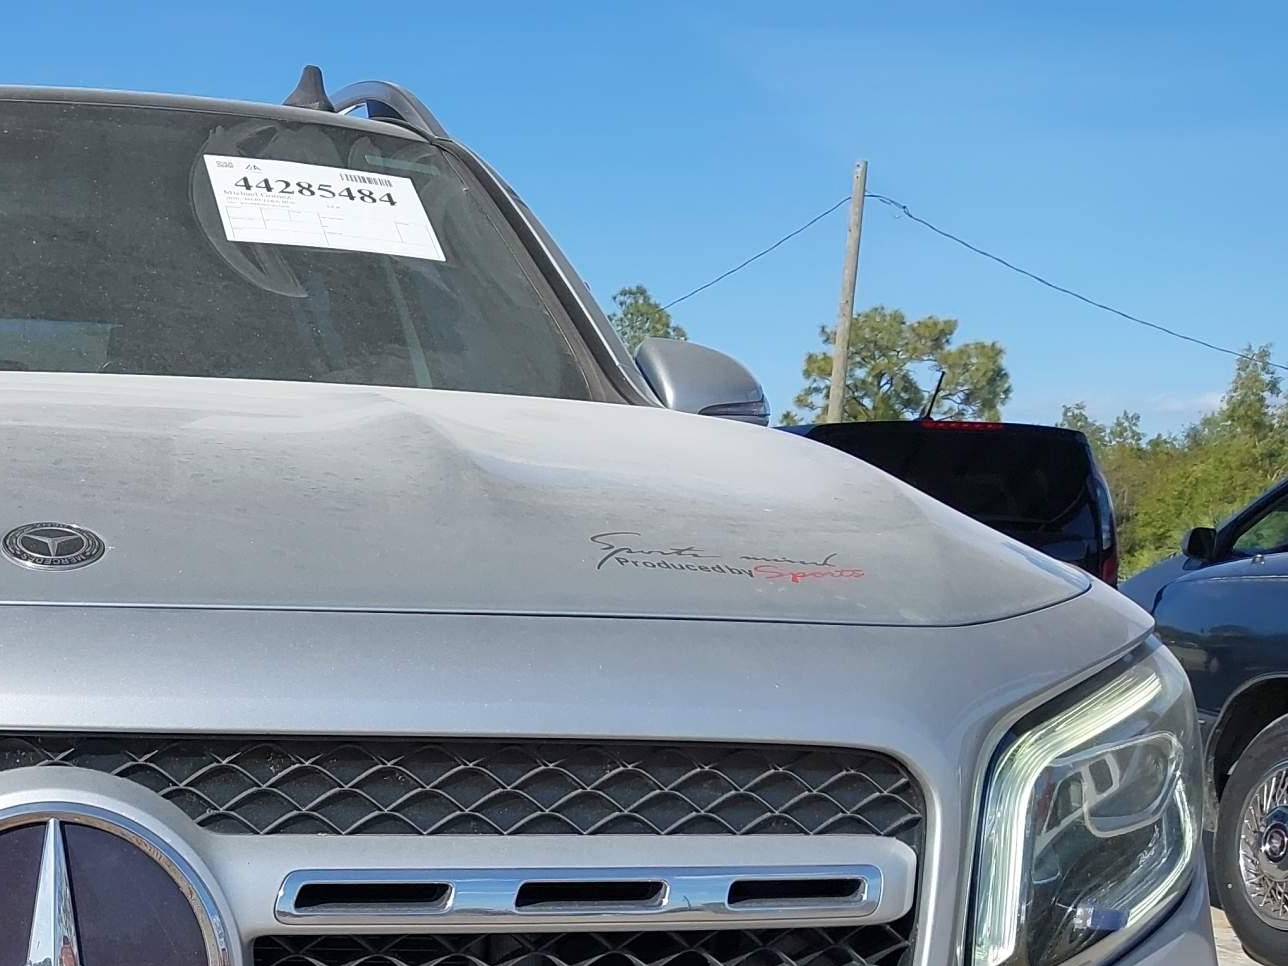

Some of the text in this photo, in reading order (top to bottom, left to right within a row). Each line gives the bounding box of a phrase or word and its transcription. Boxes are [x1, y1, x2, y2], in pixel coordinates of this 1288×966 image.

[233, 175, 398, 207] 44285484
[20, 553, 87, 565] MERCEDES
[753, 564, 865, 583] Sports
